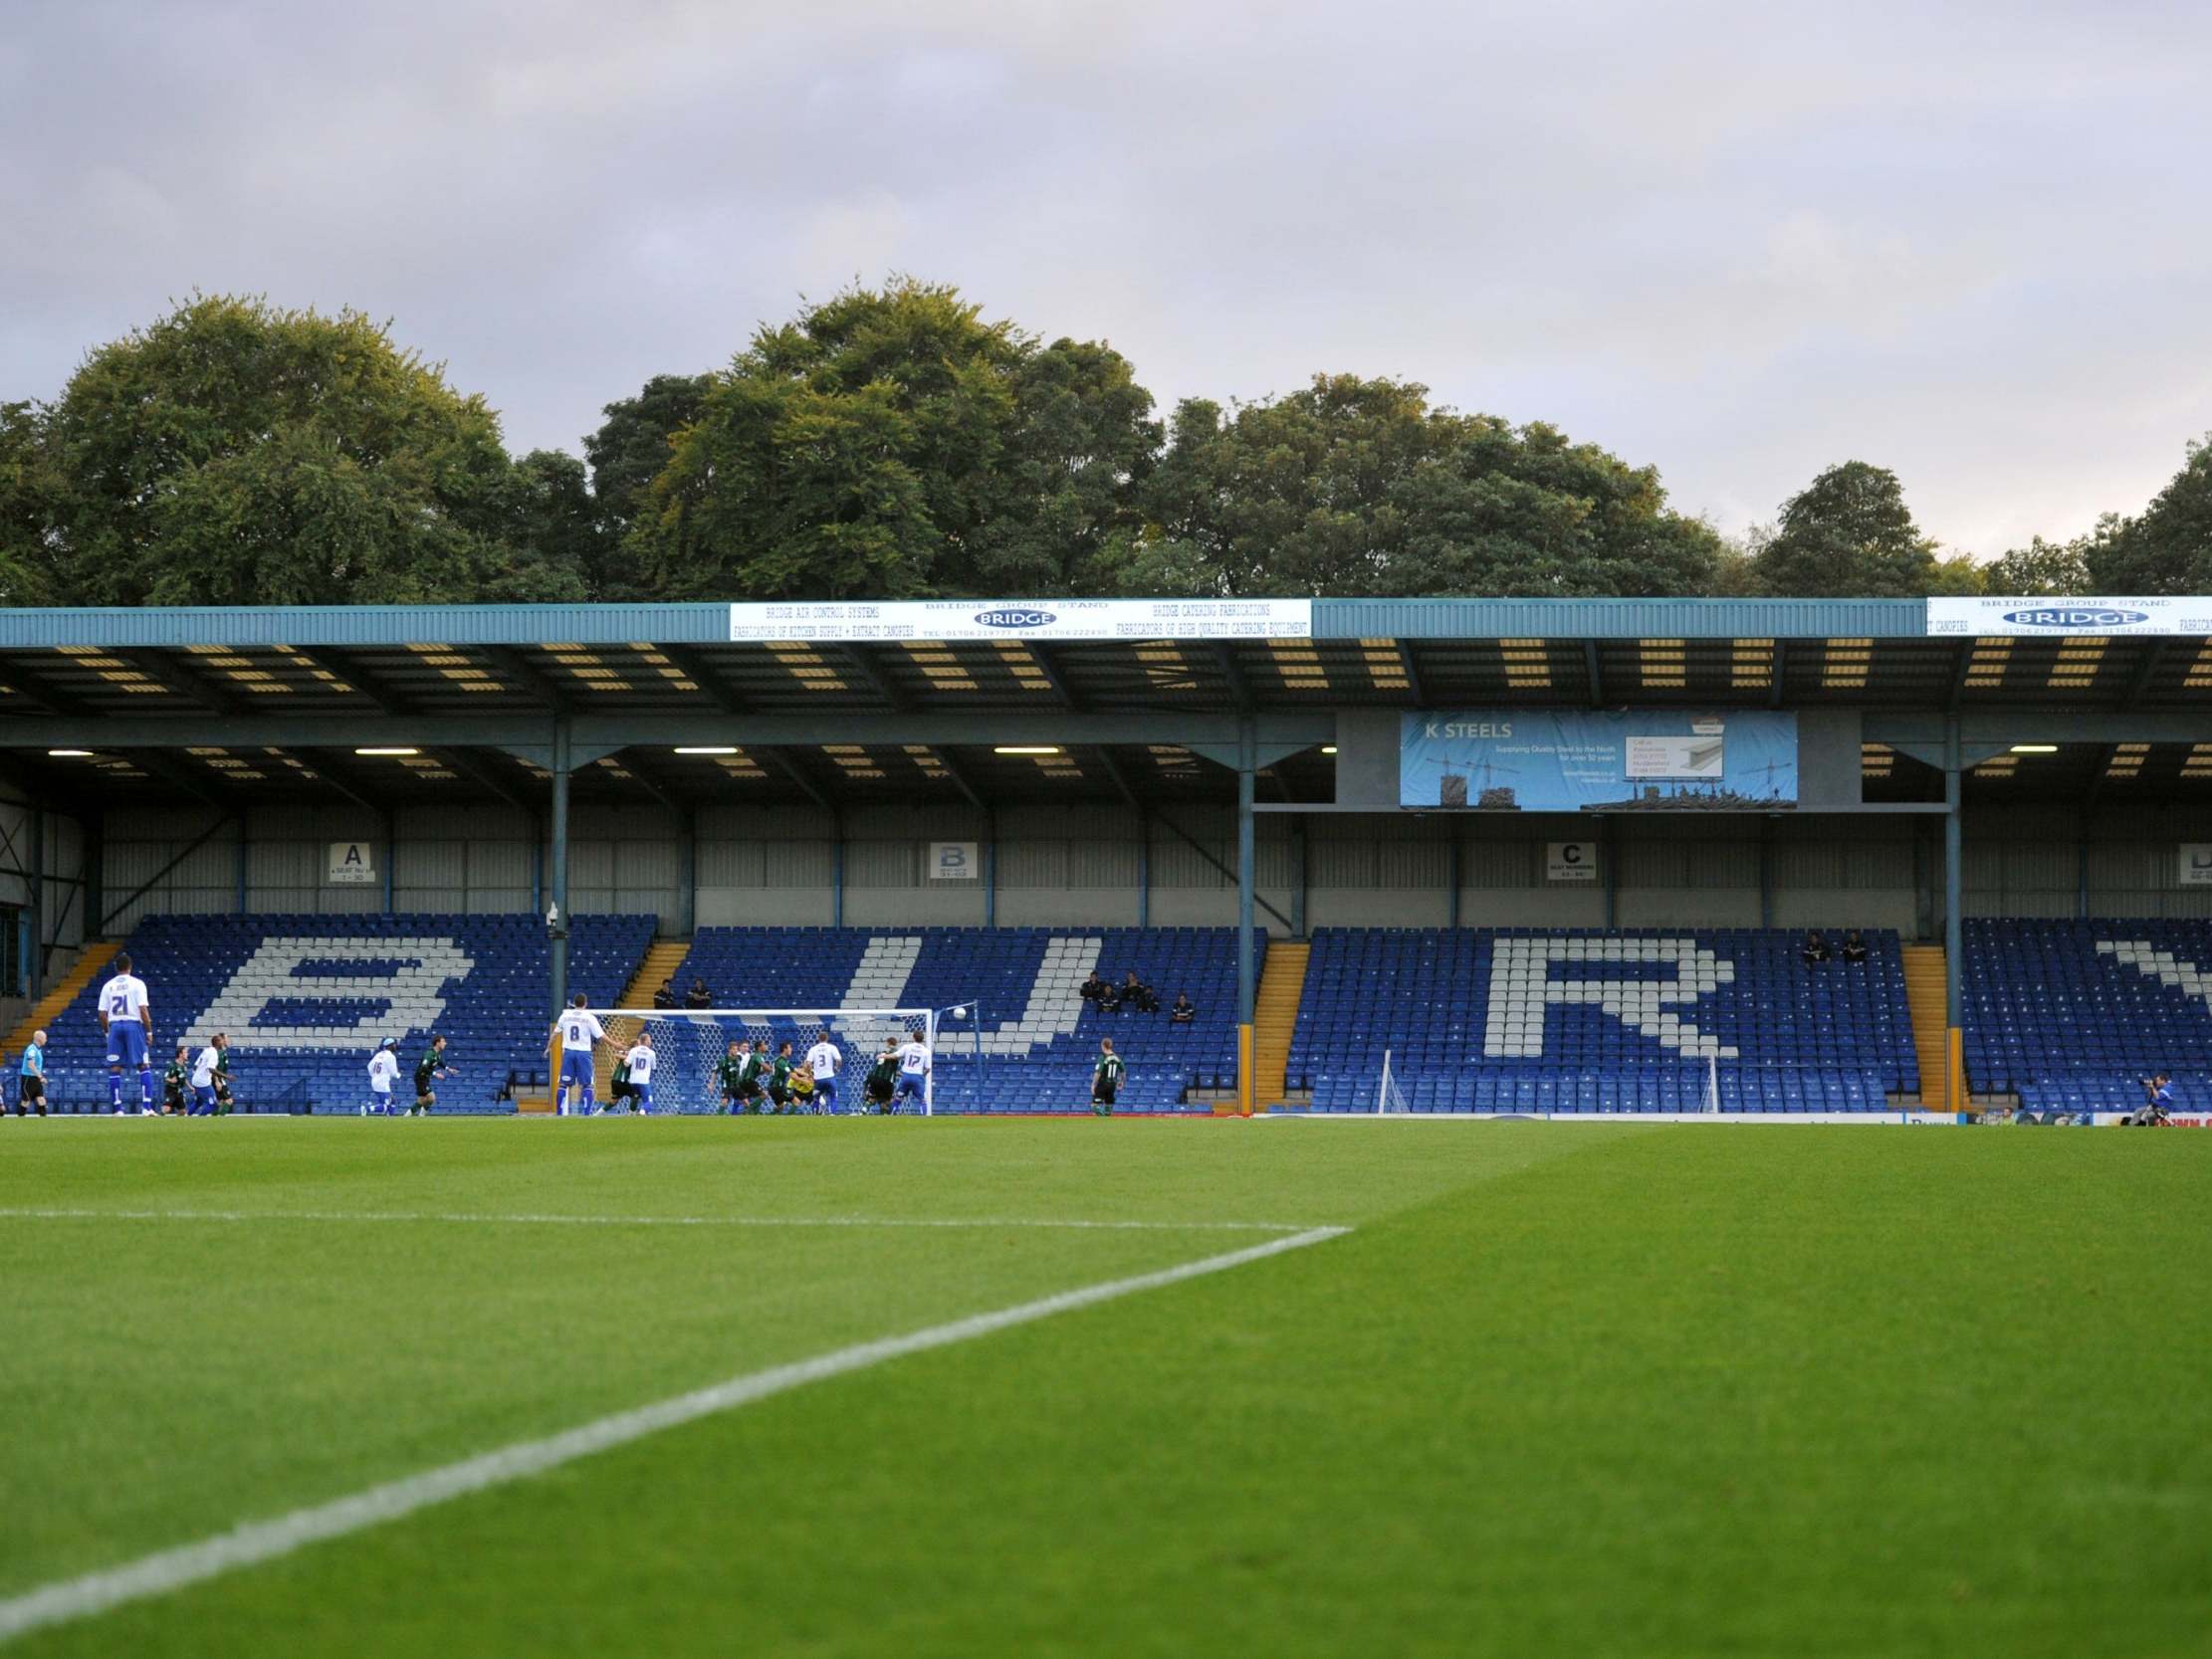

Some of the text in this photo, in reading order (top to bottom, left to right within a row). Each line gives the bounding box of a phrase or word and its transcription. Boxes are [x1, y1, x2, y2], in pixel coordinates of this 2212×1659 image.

[980, 612, 1051, 625] BRIDGE
[2014, 611, 2139, 624] BRIDGE
[1426, 723, 1513, 738] K STEELS
[344, 845, 362, 865] A
[941, 847, 966, 867] B
[1563, 844, 1581, 864] C
[177, 936, 476, 1051] B
[1483, 937, 1739, 1057] R
[112, 995, 127, 1016] 21
[570, 1025, 579, 1042] 8
[635, 1058, 646, 1070] 10
[819, 1054, 826, 1068] 3
[908, 1054, 922, 1067] 17
[1107, 1064, 1117, 1078] 11
